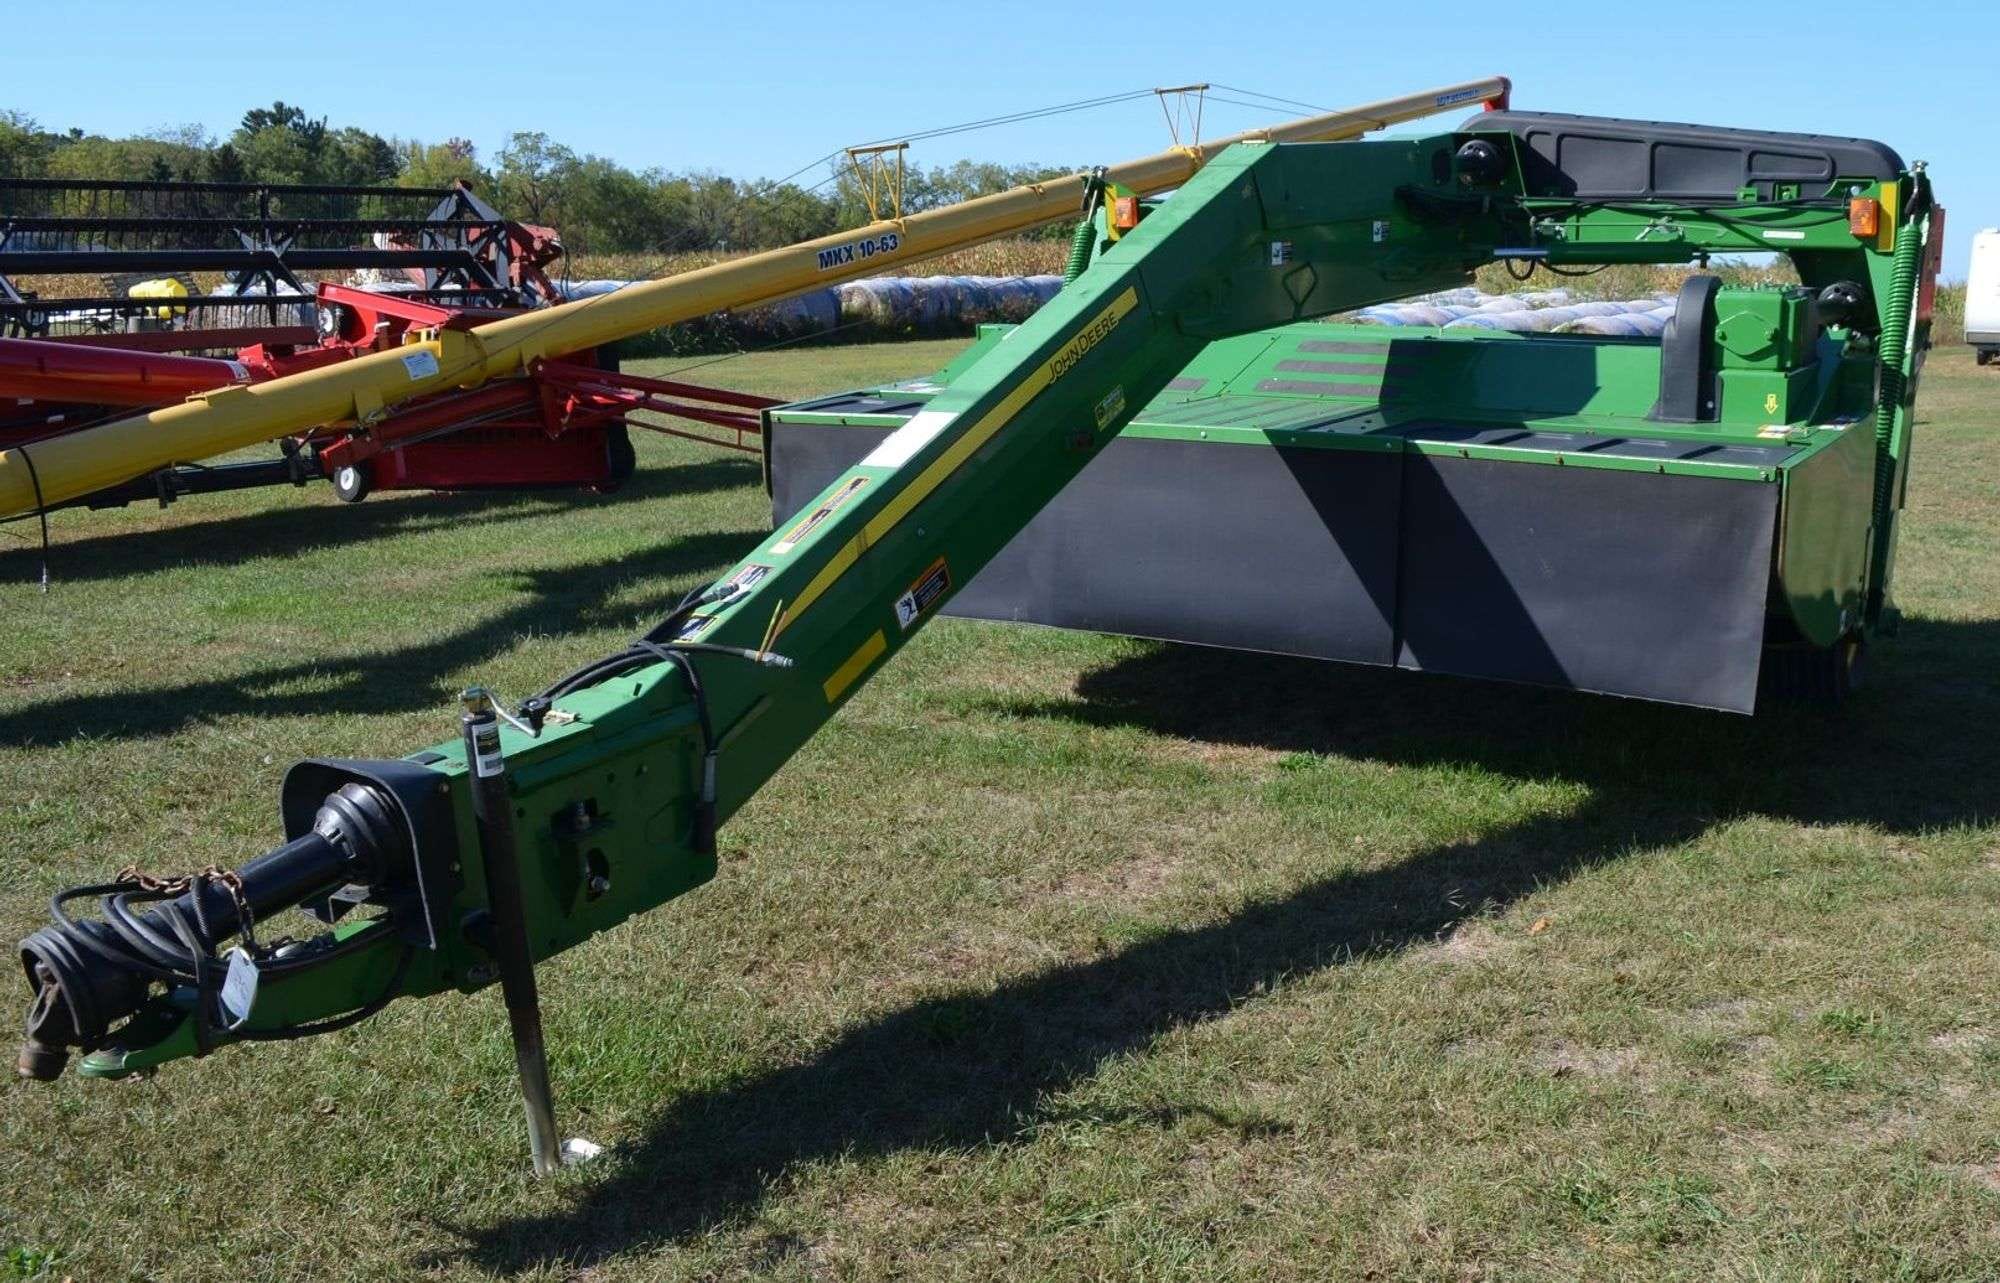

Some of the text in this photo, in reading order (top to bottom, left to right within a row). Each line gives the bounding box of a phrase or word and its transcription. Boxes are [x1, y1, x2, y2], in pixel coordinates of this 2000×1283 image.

[818, 233, 898, 270] MKX 10-63
[1049, 311, 1119, 384] JOHN DEERE
